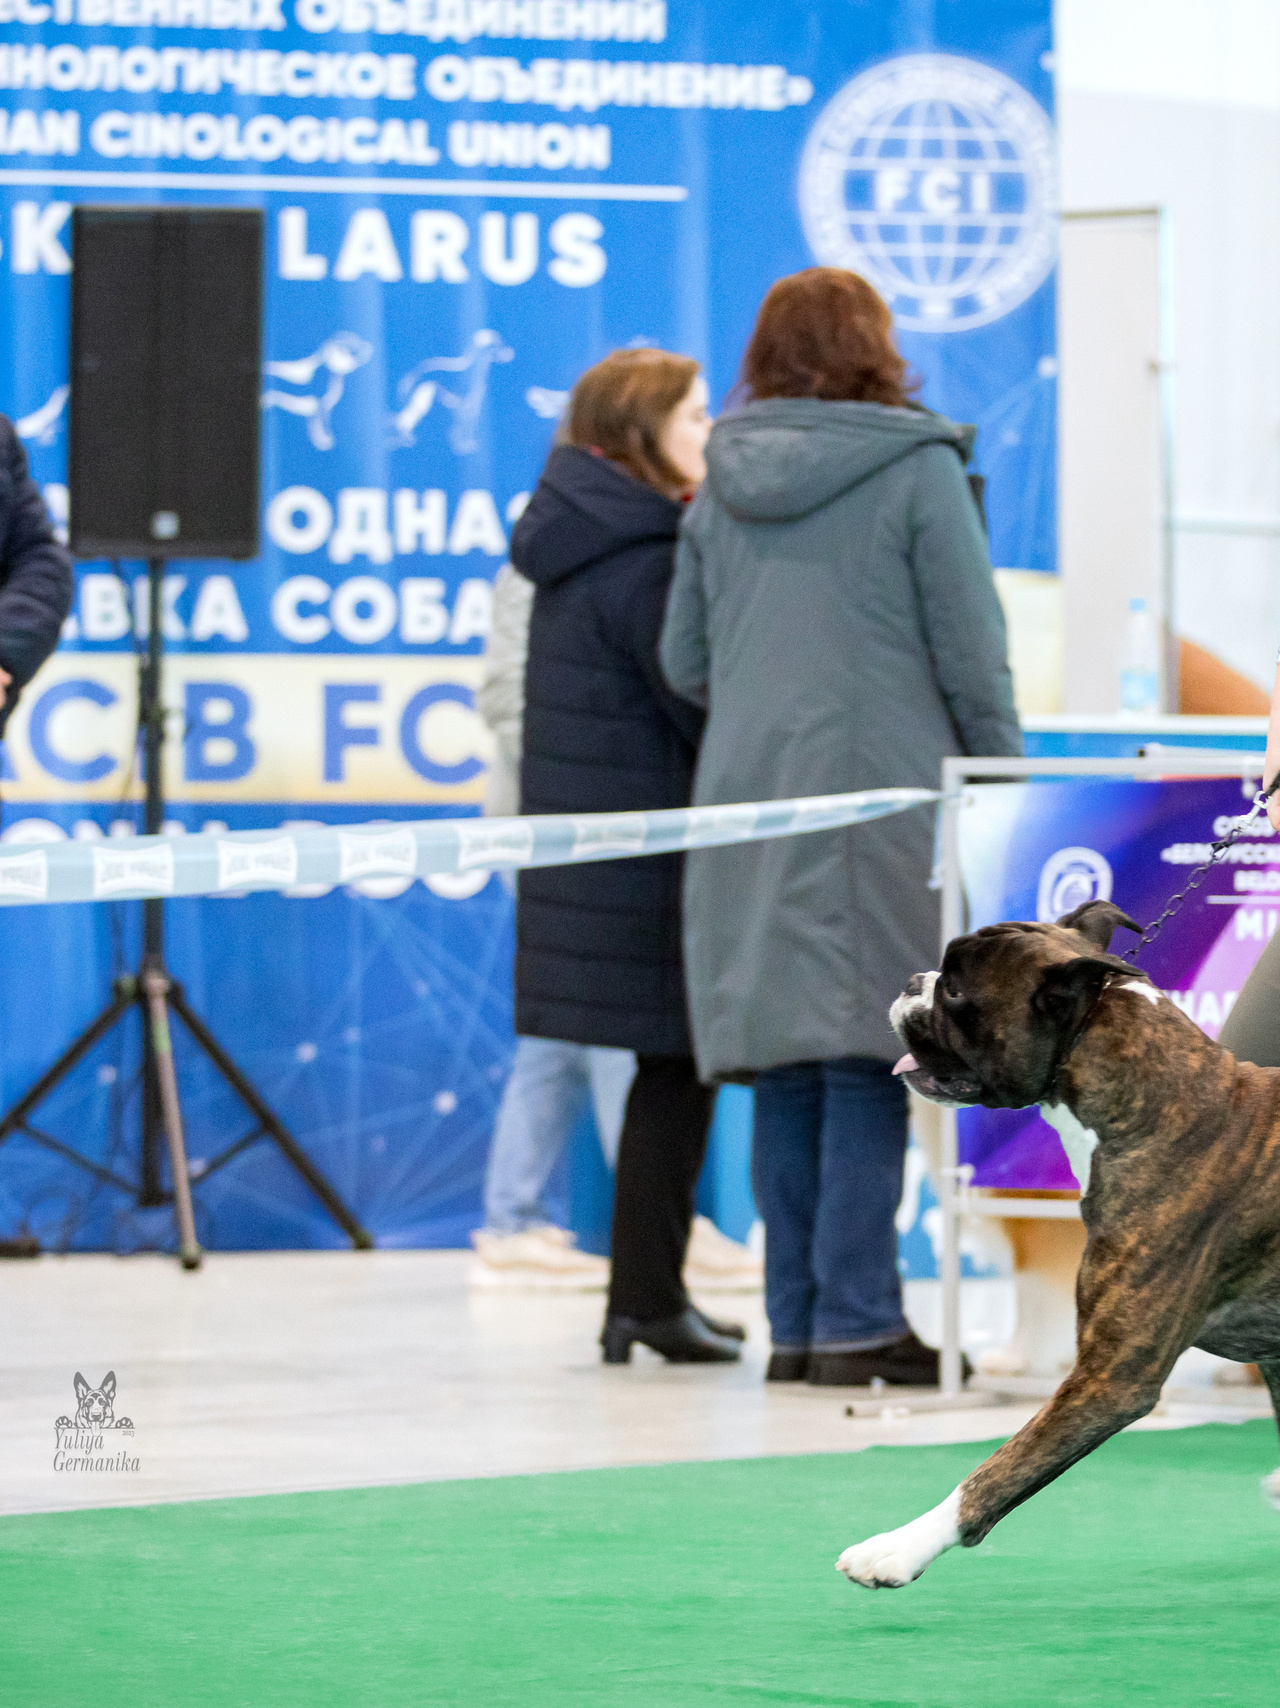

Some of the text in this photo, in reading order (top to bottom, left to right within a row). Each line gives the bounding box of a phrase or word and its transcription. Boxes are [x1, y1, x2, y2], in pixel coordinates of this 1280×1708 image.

[90, 111, 440, 165] CINOLOGICAL
[448, 121, 610, 169] UNION
[874, 168, 990, 216] FCI
[278, 206, 607, 287] LARUS
[271, 576, 492, 644] СОБА
[322, 681, 488, 783] FC
